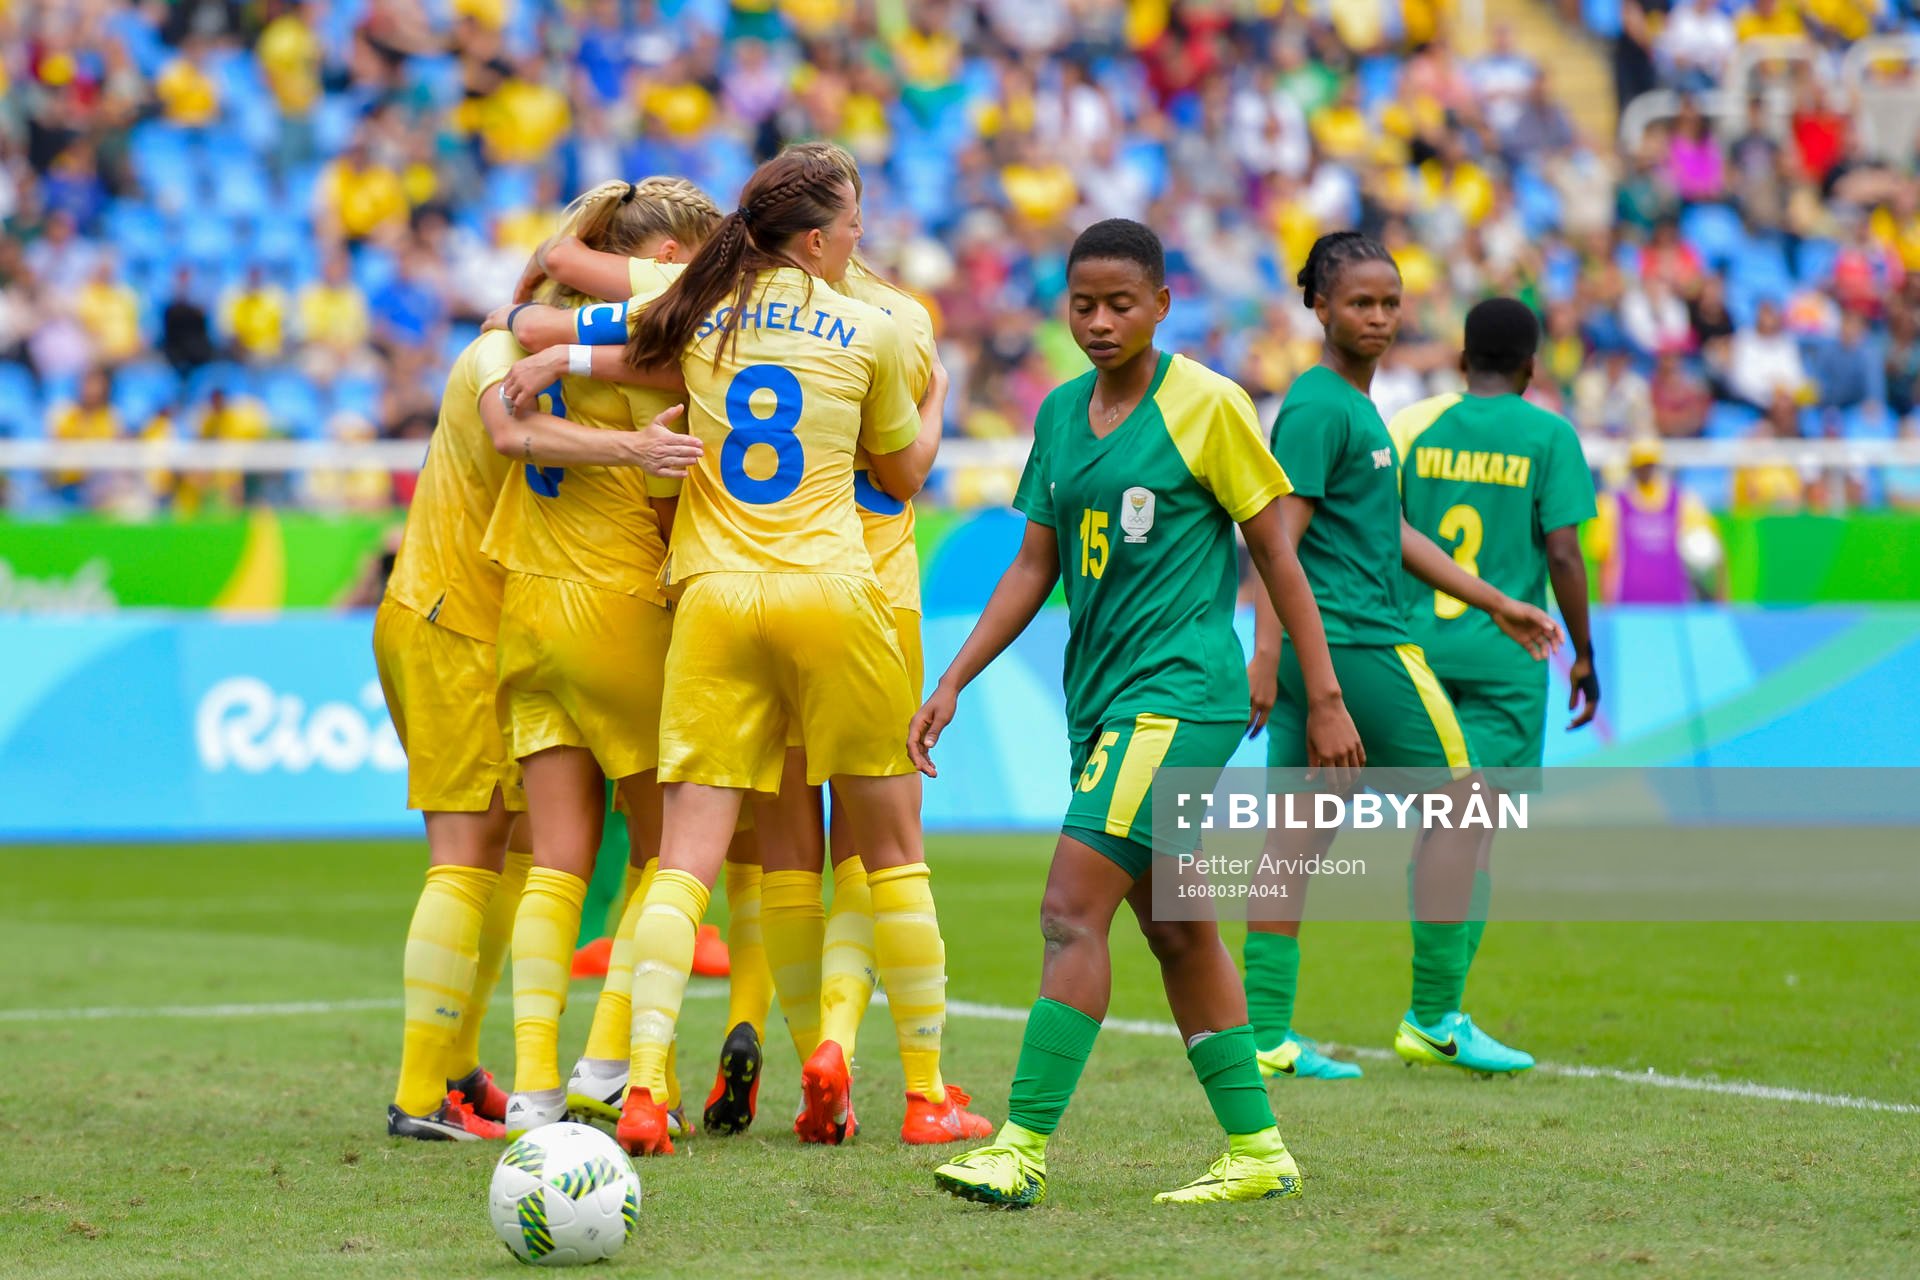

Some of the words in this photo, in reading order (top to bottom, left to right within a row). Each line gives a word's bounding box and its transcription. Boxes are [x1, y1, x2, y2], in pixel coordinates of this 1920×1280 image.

[582, 303, 623, 326] C
[696, 302, 856, 349] SCHELIN
[720, 364, 804, 505] 8
[1416, 447, 1530, 488] VILAKAZI
[1080, 508, 1109, 579] 15
[1434, 504, 1484, 620] 3
[1074, 731, 1120, 793] 5
